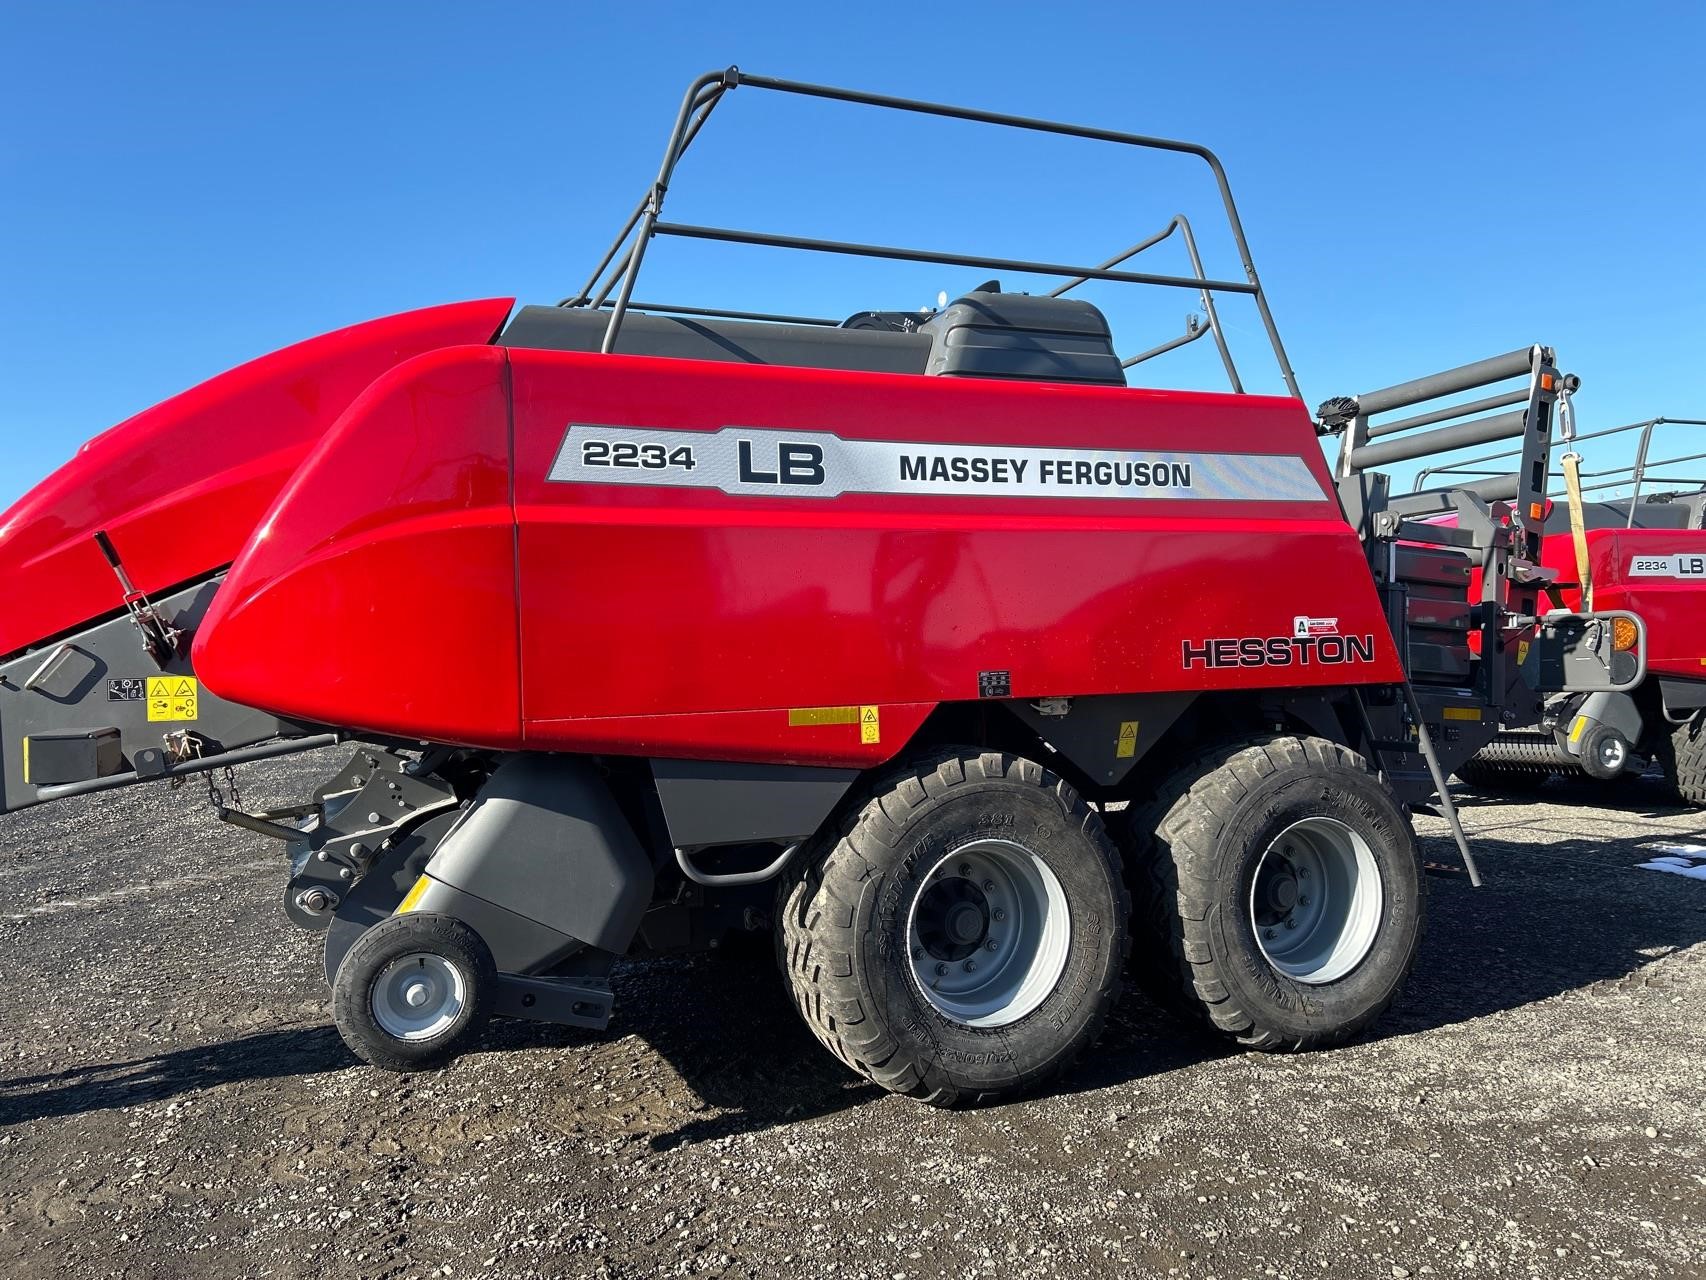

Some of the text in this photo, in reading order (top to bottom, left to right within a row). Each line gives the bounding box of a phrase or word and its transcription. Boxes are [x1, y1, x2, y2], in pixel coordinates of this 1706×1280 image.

[583, 441, 696, 470] 2234
[738, 440, 826, 486] LB
[899, 455, 1193, 487] MASSEY FERGUSON
[1636, 561, 1668, 571] 2234
[1678, 558, 1704, 574] LB
[1182, 635, 1375, 669] HESSTON
[978, 813, 1015, 828] 381
[1049, 930, 1101, 1032] ALLIANCE
